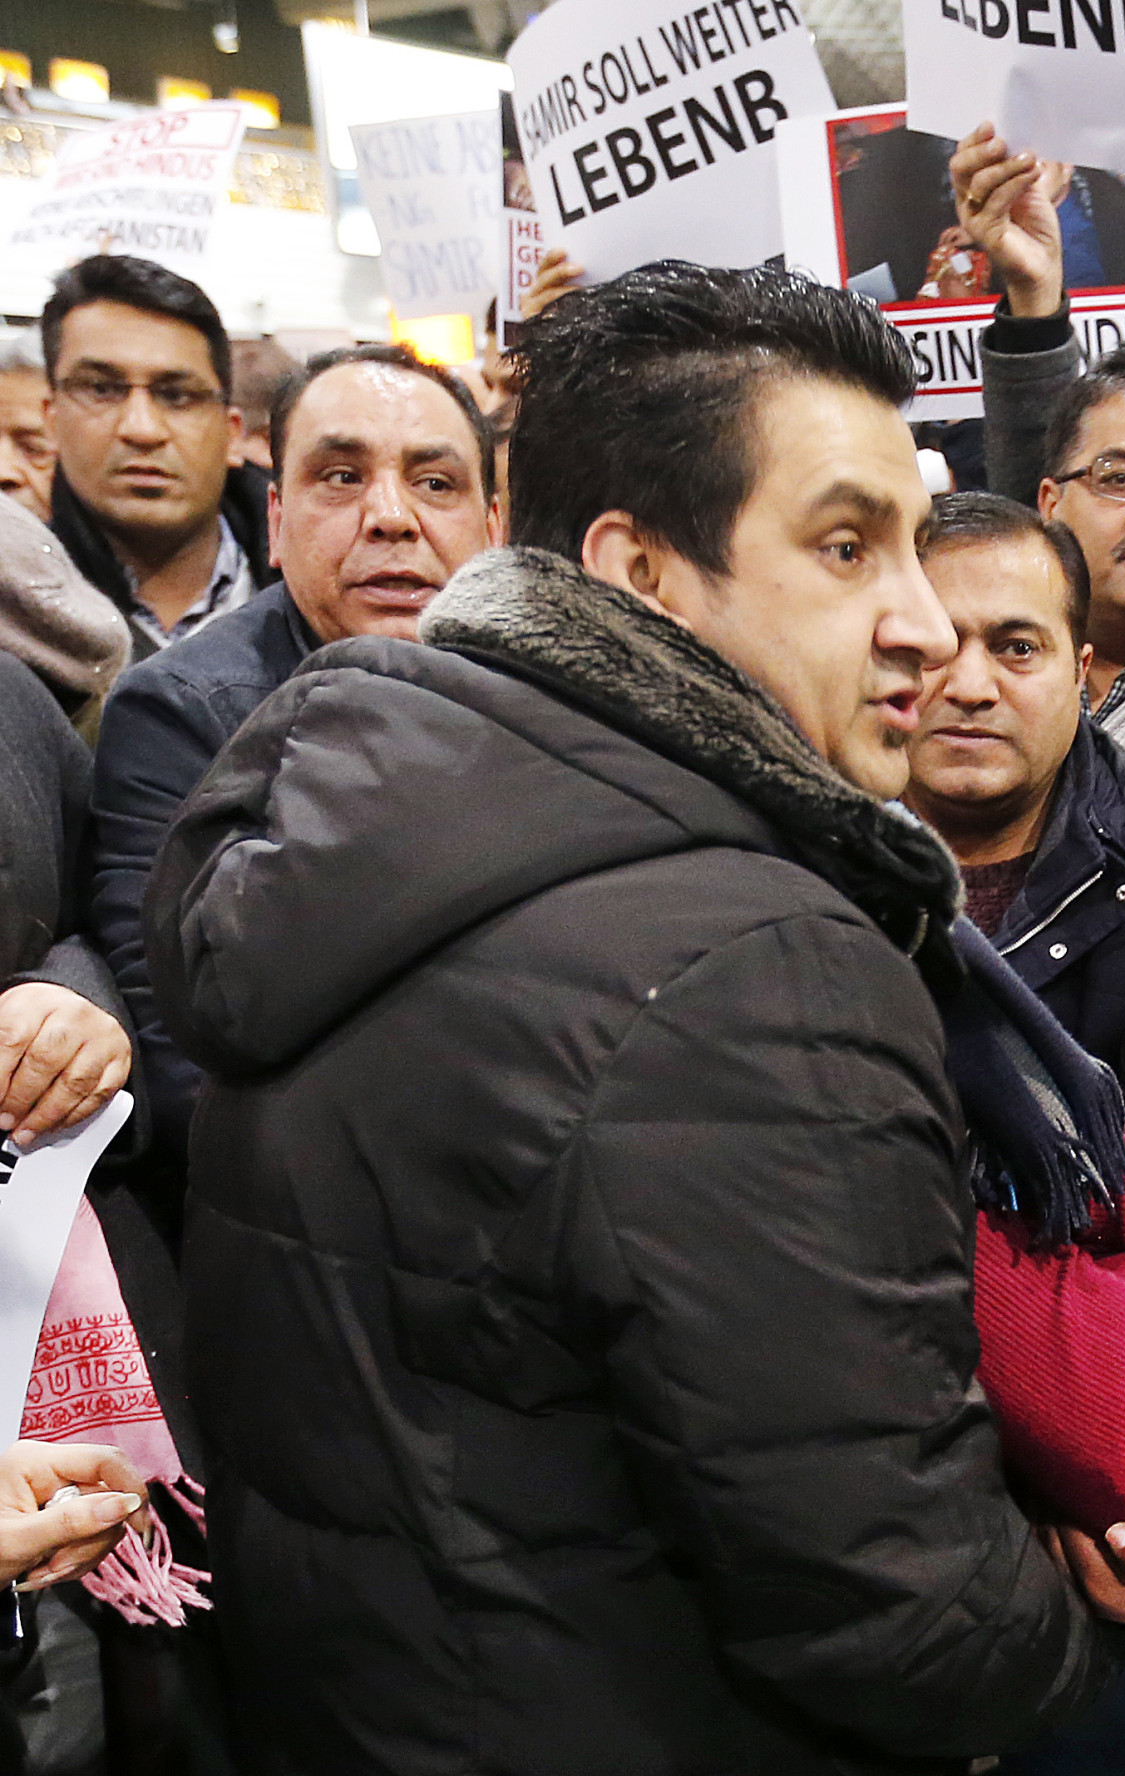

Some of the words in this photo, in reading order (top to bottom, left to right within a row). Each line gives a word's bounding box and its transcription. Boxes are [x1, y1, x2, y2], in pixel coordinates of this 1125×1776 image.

[522, 74, 588, 161] SAMIR
[582, 36, 670, 115] SOLL
[658, 0, 800, 76] WEITER
[550, 70, 788, 227] LEBENB
